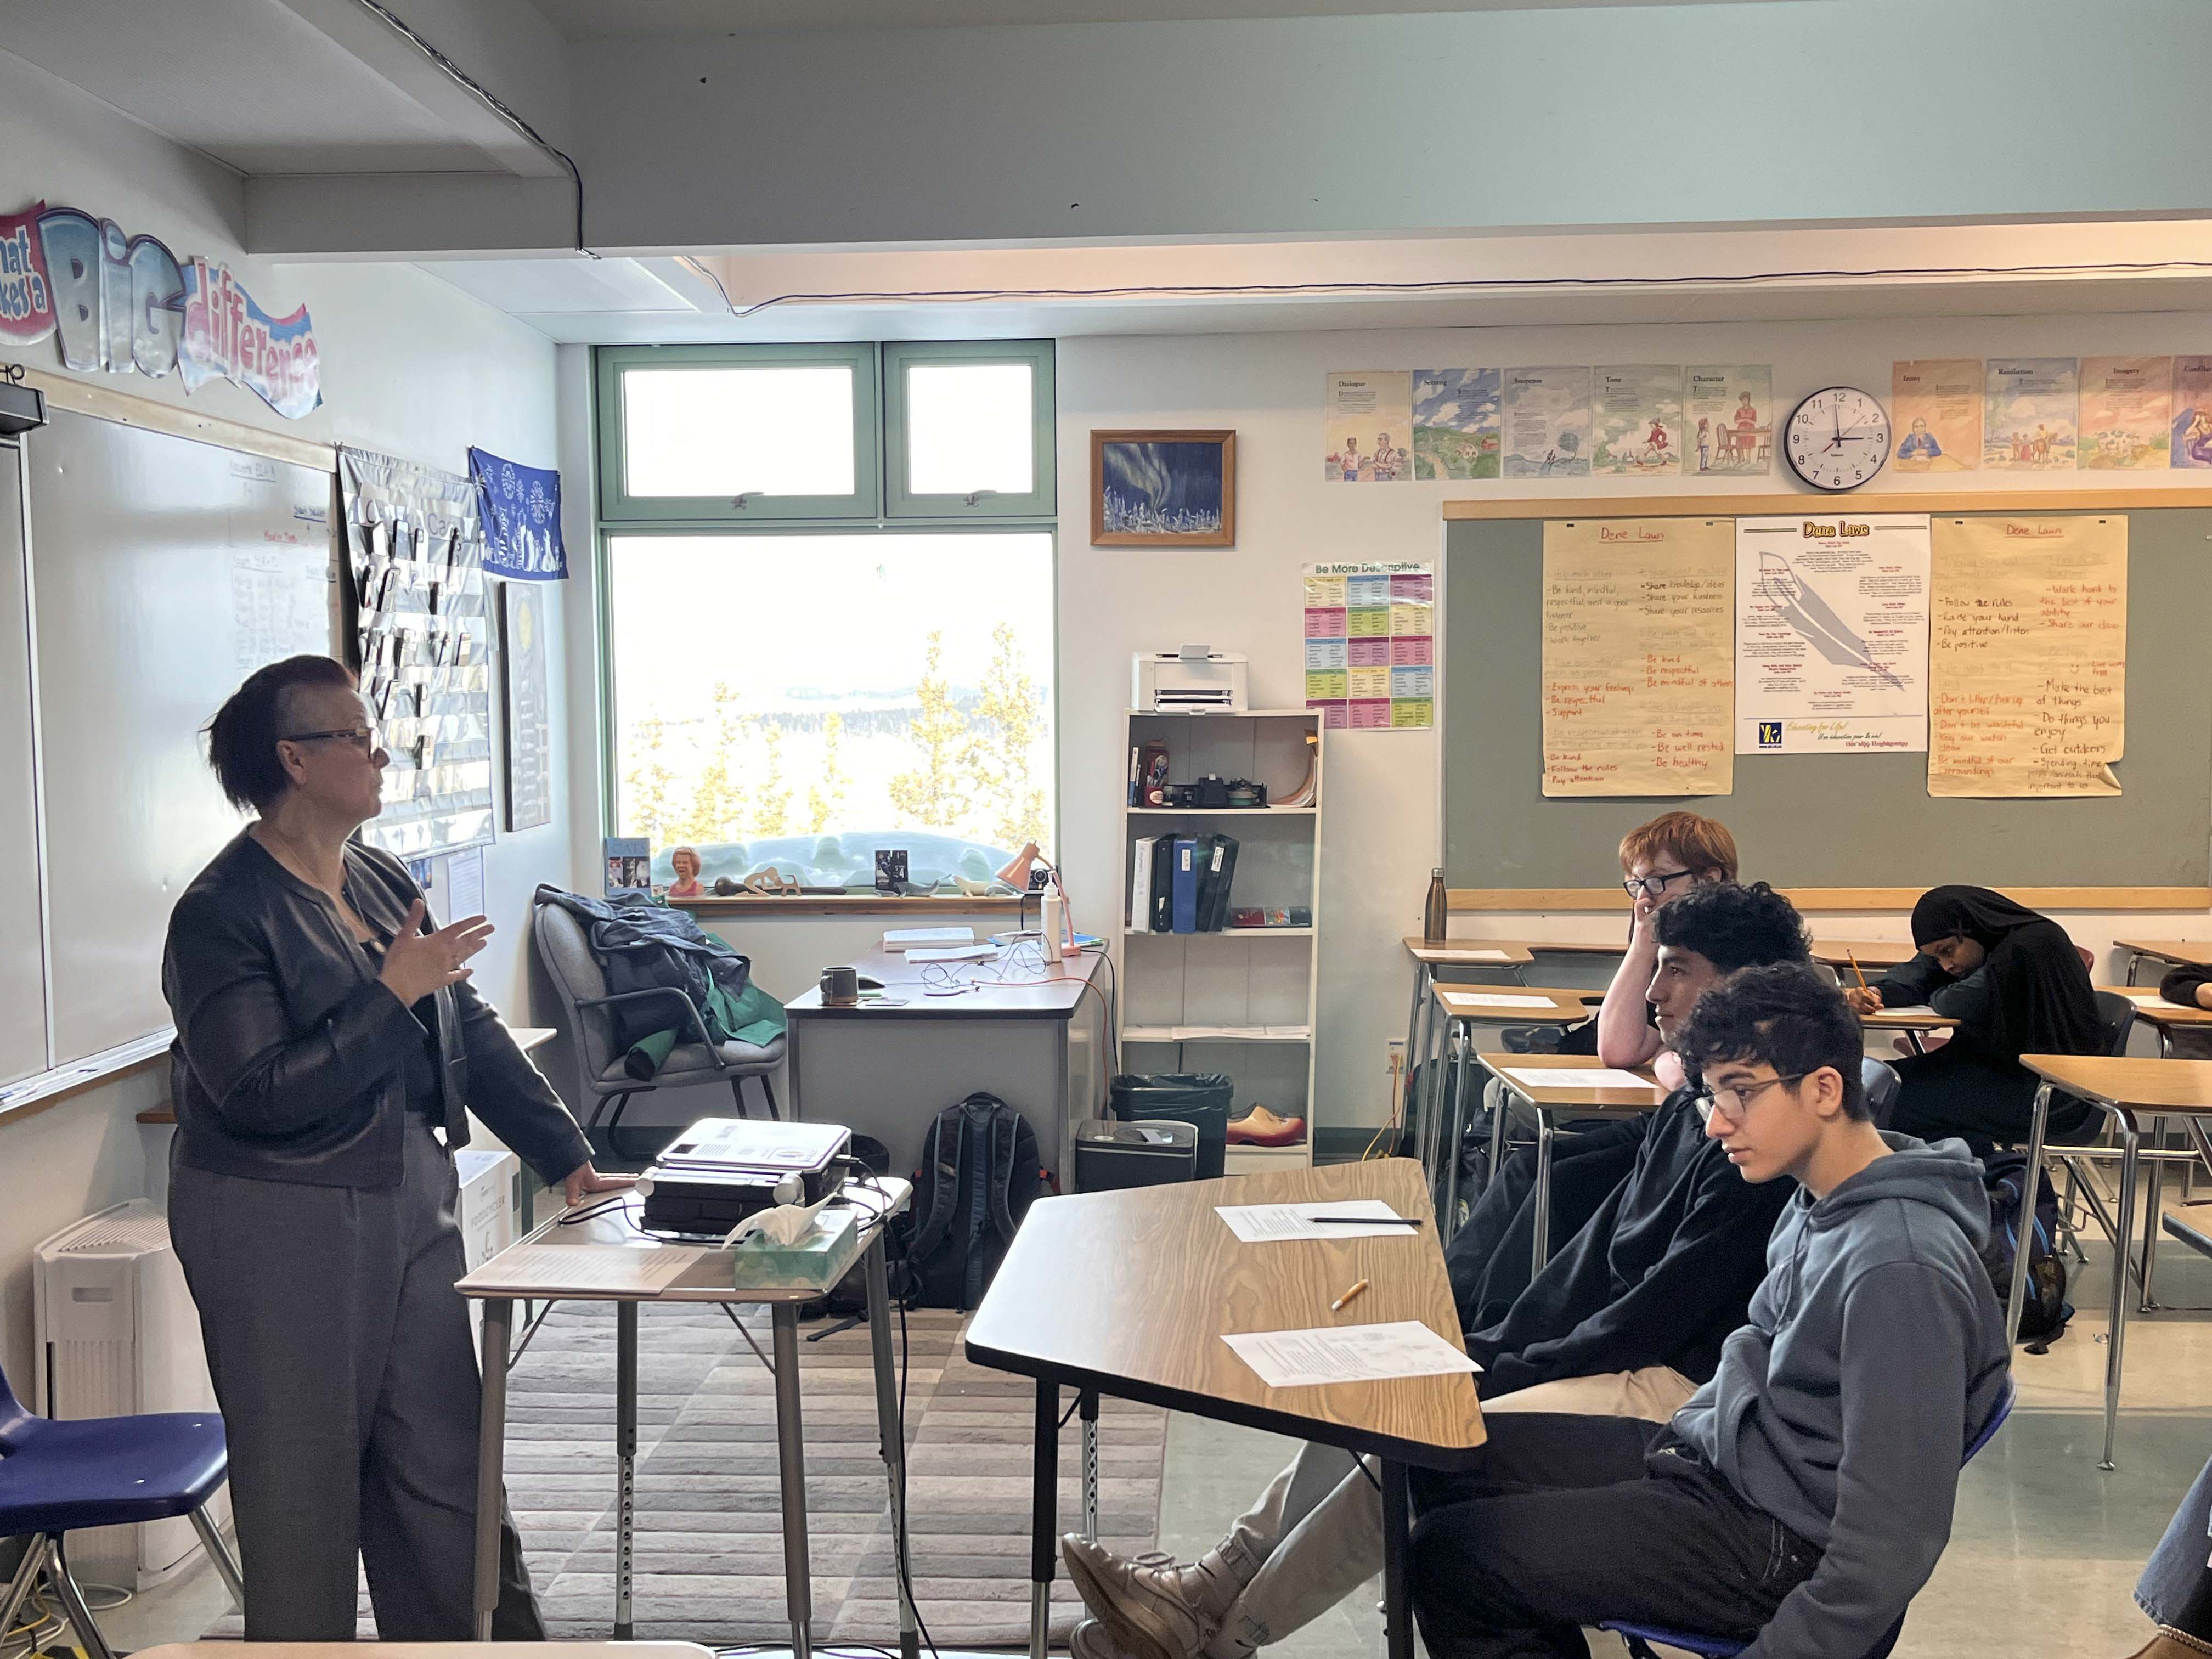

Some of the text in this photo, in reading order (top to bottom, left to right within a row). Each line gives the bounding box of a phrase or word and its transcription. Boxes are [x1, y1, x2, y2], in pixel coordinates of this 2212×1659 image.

[1833, 393, 1846, 402] 12
[1858, 398, 1862, 407] 1
[1812, 399, 1822, 409] 11
[1797, 414, 1809, 424] 10
[1872, 413, 1879, 423] 2
[1793, 434, 1800, 443] 9
[1876, 433, 1883, 443] 3
[1798, 455, 1805, 465] 8
[1870, 455, 1877, 464] 4
[1812, 470, 1819, 479] 7
[1855, 470, 1862, 479] 5
[1833, 476, 1841, 486] 6
[1601, 527, 1664, 540] Dene Laws
[1803, 520, 1870, 538] Dene Laws
[2007, 524, 2062, 535] Dene Laws
[1316, 562, 1420, 574] Be More Descriptive
[2081, 584, 2102, 592] hard
[2108, 584, 2117, 592] to
[1672, 594, 1689, 603] your
[1992, 597, 2013, 607] rules
[2062, 597, 2078, 606] best
[2096, 599, 2117, 607] your
[1670, 607, 1689, 617] your
[2040, 608, 2070, 616] ability
[1973, 614, 1991, 623] your
[1998, 613, 2019, 621] hand
[1955, 640, 1988, 652] positive
[1661, 665, 1699, 676] respectful
[1699, 678, 1707, 686] of
[1584, 685, 1602, 694] your
[2074, 682, 2089, 693] the
[2094, 684, 2112, 696] best
[2036, 695, 2081, 709] of things
[1934, 706, 1990, 718] after yourself
[2058, 713, 2087, 729] things
[2093, 715, 2110, 730] you
[2034, 727, 2066, 742] enjoy
[1675, 742, 1692, 751] well
[1697, 742, 1724, 751] rested
[2064, 743, 2106, 754] outdoors
[1673, 756, 1707, 770] healthy
[1570, 775, 1604, 783] attention
